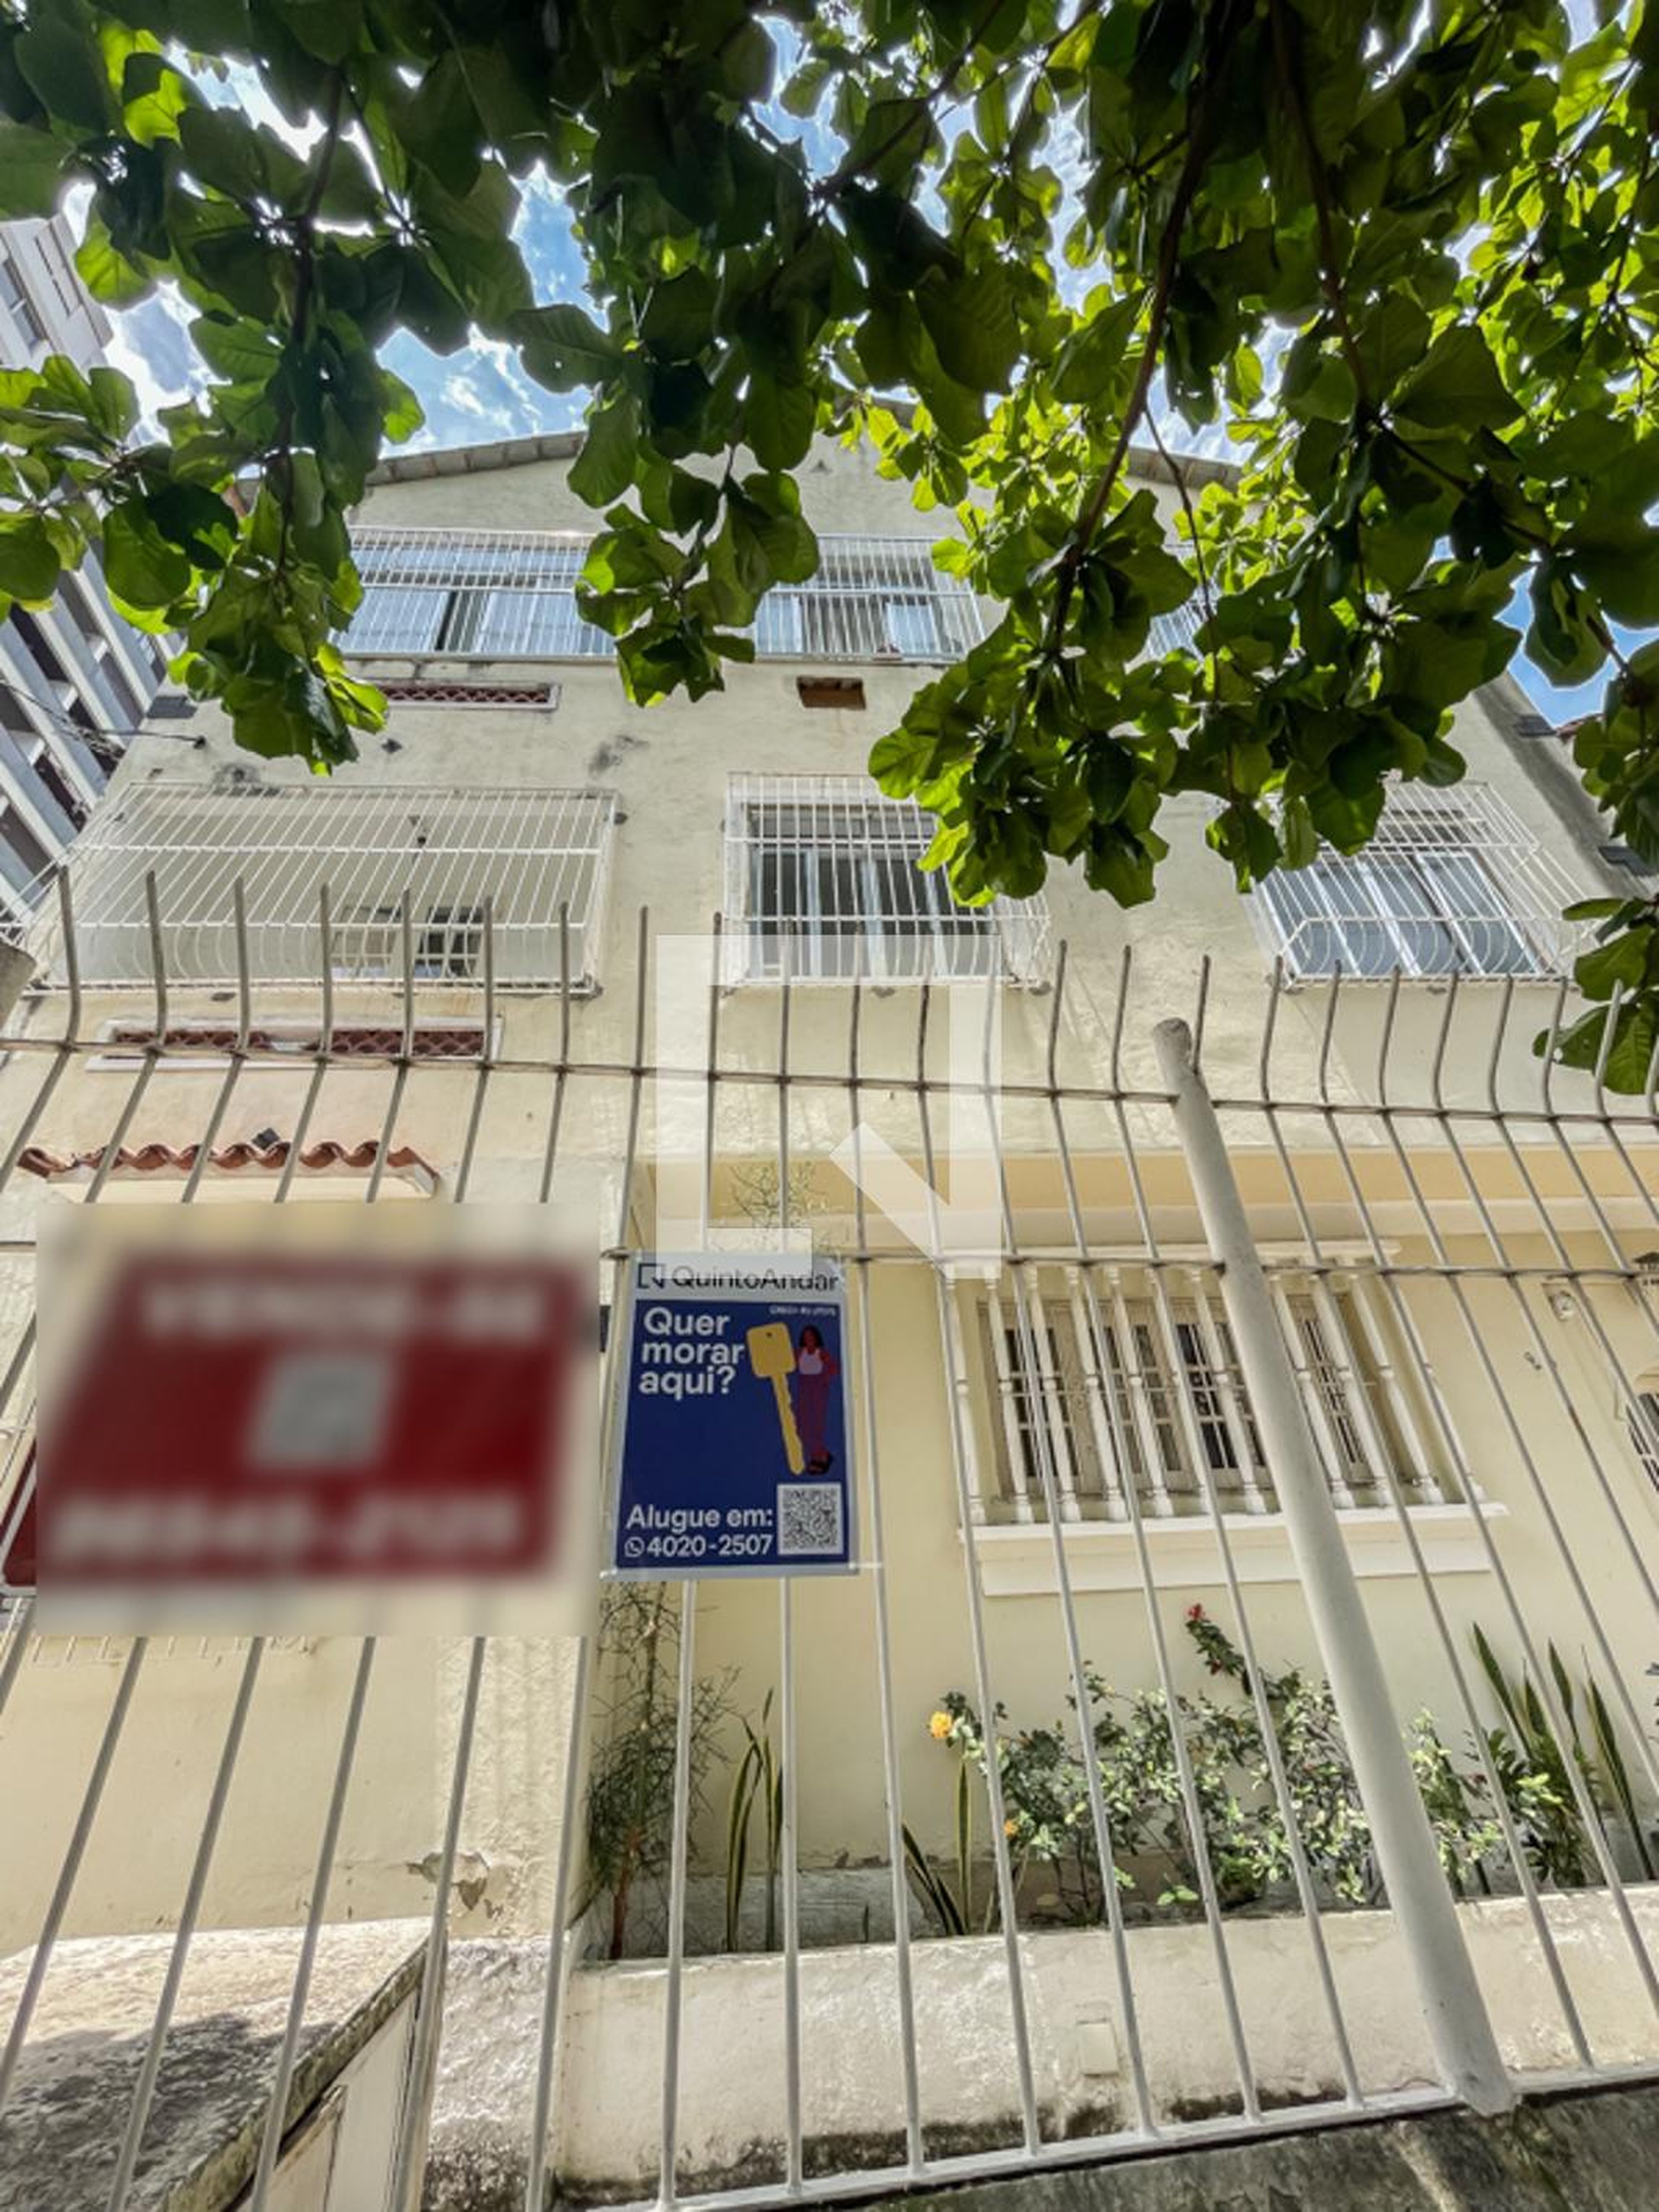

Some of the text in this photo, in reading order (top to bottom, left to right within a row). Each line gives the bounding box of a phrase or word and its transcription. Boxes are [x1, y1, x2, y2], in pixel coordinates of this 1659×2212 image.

[672, 1265, 839, 1291] QuintoAndar
[644, 1307, 730, 1335] Quer
[642, 1342, 745, 1364] morar
[639, 1366, 735, 1400] aqui?
[626, 1504, 772, 1533] Alugue em:
